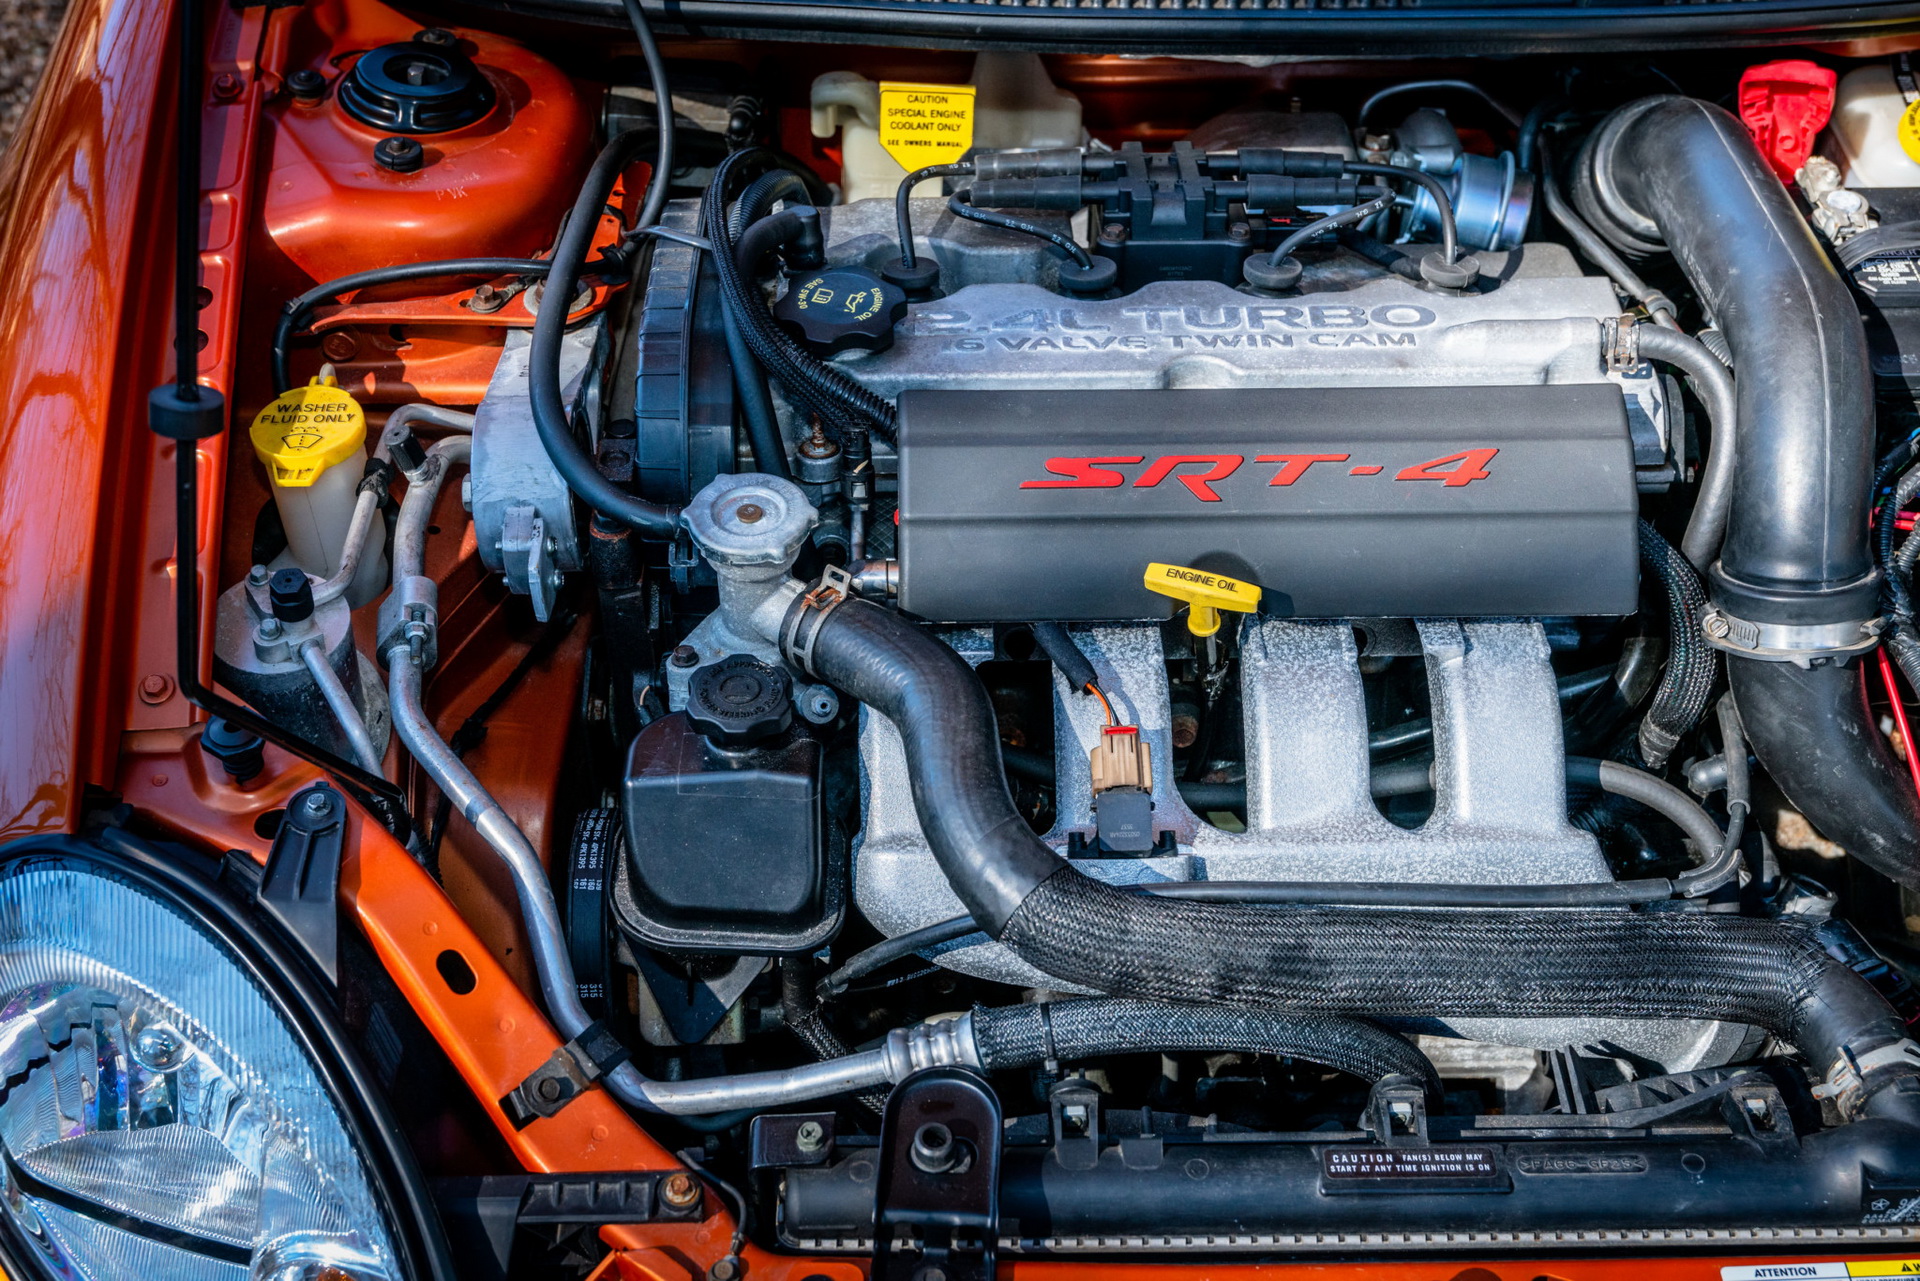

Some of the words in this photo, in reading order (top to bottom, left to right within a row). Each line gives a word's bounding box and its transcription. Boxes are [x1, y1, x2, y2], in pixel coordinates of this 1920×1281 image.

[907, 94, 949, 104] CAUTION
[887, 108, 928, 118] SPECIAL
[930, 109, 967, 119] ENGINE
[890, 121, 935, 131] COOLANT
[937, 122, 962, 132] ONLY
[904, 139, 932, 147] OWNERS
[805, 278, 824, 291] SAE
[797, 289, 809, 310] 5W-30
[870, 287, 884, 313] ENGINE
[854, 311, 873, 321] OIL
[914, 308, 1111, 337] 2.4L
[1121, 303, 1437, 333] TURBO
[996, 335, 1148, 351] VALVE
[1161, 333, 1294, 350] TWIN
[1308, 333, 1417, 348] CAM
[277, 403, 349, 413] WASHER
[260, 414, 308, 424] FLUID
[313, 413, 356, 424] ONLY
[1019, 448, 1501, 503] SRT-4
[1166, 567, 1217, 587] ENGINE
[1217, 579, 1239, 593] OIL
[578, 842, 588, 869] 4PK1395
[588, 842, 599, 869] 4PK1395
[579, 878, 588, 890] 161
[587, 878, 596, 891] 160
[580, 983, 589, 998] 315
[589, 983, 599, 998] 315
[1332, 1154, 1394, 1163] CAUTION
[1402, 1153, 1432, 1162] FAN(S)
[1434, 1153, 1463, 1162] BELOW
[1466, 1153, 1483, 1161] MAY
[1330, 1165, 1357, 1173] START
[1396, 1164, 1418, 1172] TIME
[1421, 1164, 1462, 1172] IGNITION
[1465, 1164, 1475, 1172] IS
[1478, 1163, 1491, 1171] ON
[1754, 1266, 1818, 1278] ATTENTION
